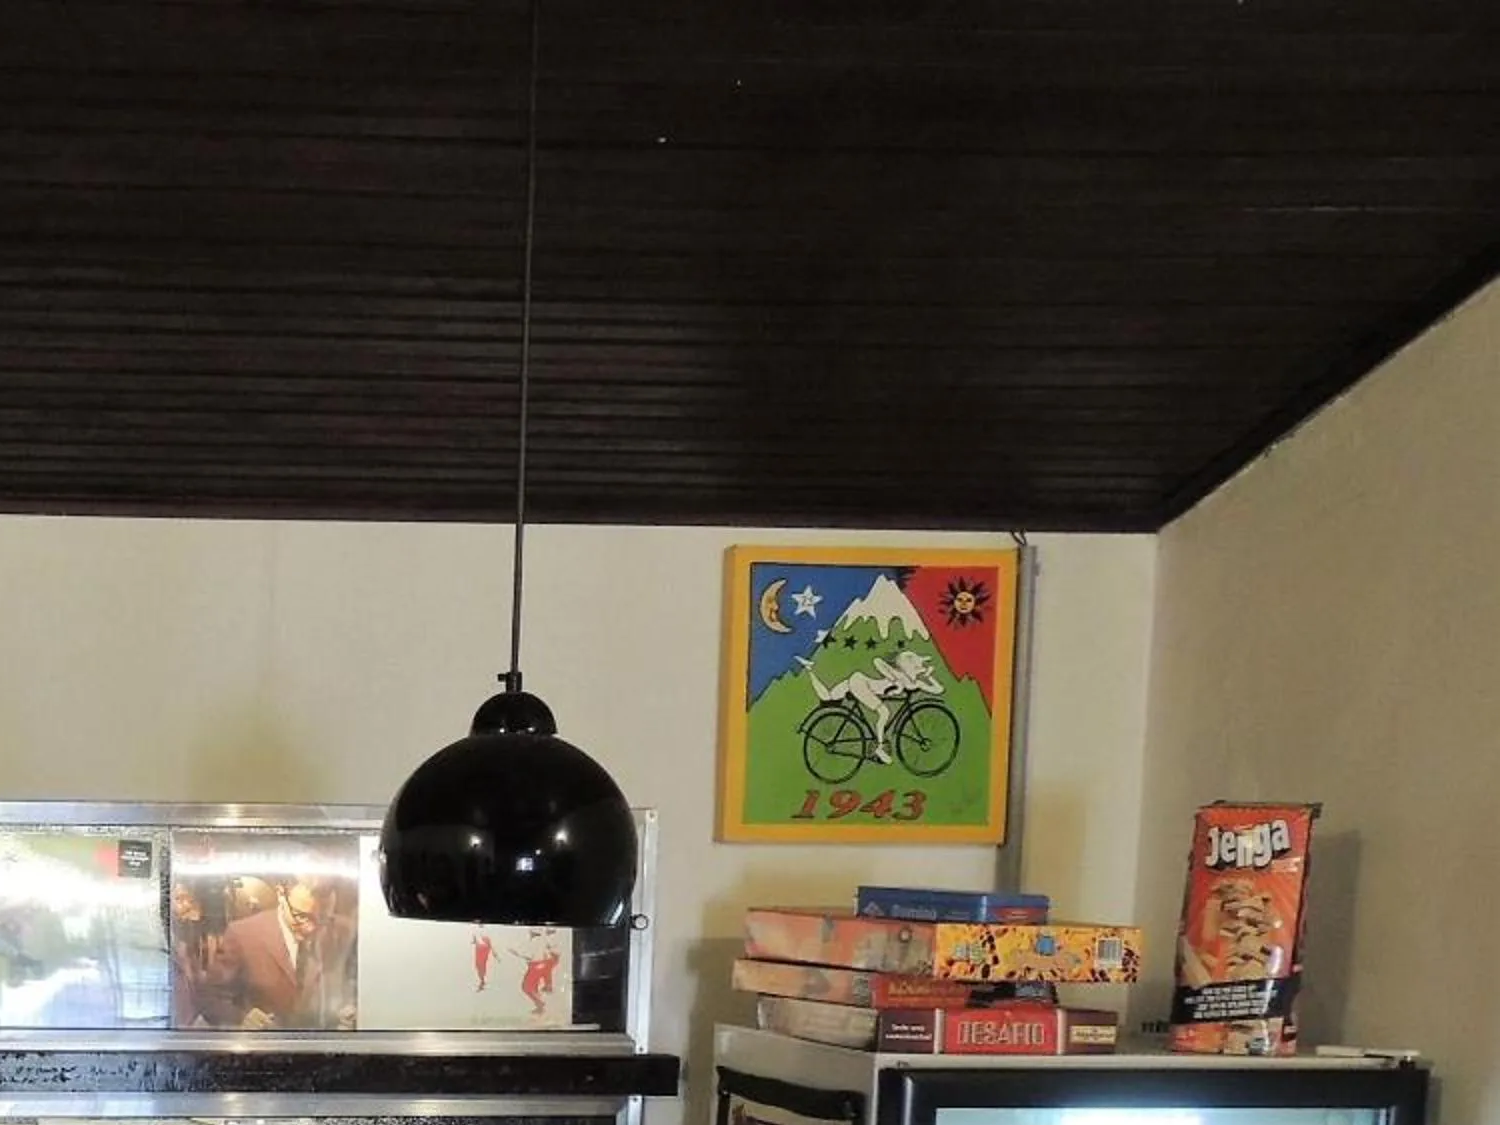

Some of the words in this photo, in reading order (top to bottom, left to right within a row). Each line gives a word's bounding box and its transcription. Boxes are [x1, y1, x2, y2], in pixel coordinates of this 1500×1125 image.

[791, 789, 927, 821] 1943
[1206, 819, 1291, 869] Jenga
[957, 1020, 1045, 1047] DESAFIO
